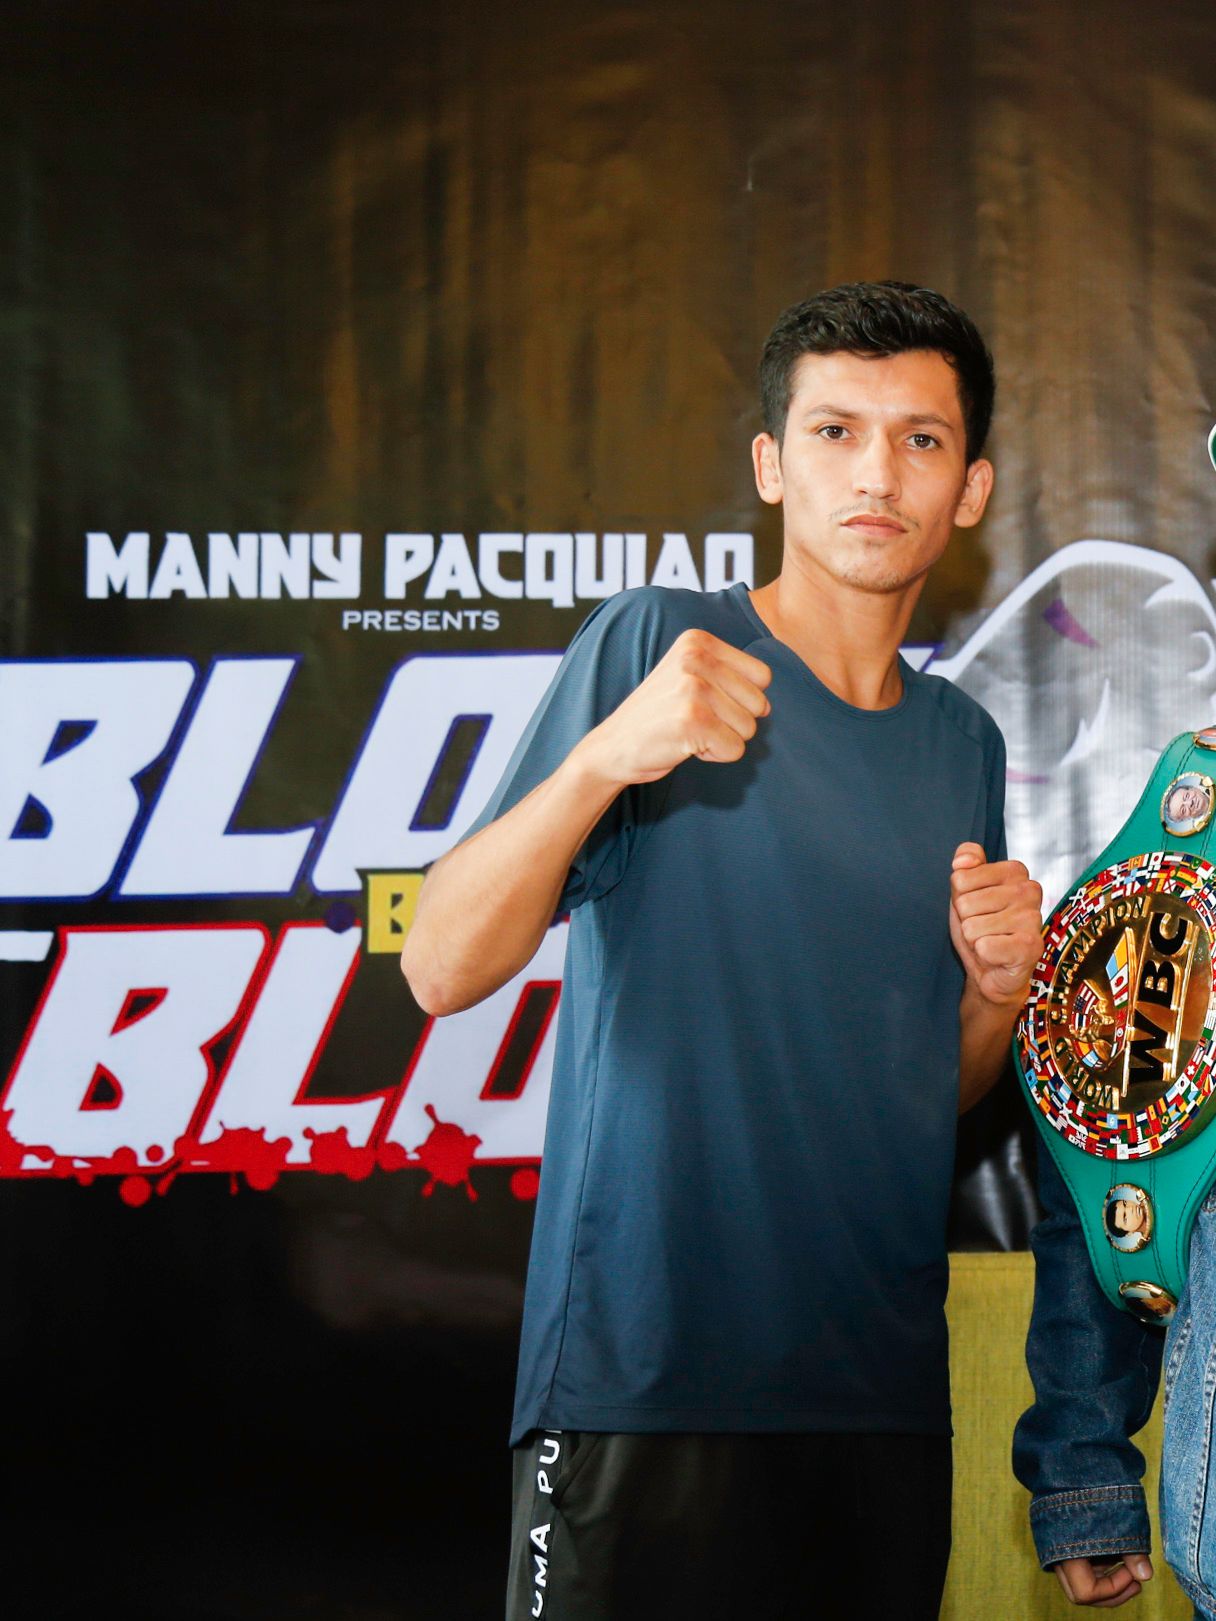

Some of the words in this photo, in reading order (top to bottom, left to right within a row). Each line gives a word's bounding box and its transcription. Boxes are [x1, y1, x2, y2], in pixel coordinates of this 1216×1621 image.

[86, 532, 362, 599] MANNY
[386, 532, 755, 608] PACQUIAO
[343, 610, 500, 631] PRESENTS
[0, 653, 568, 897] BLO
[1050, 894, 1151, 1024] CHAMPION
[1129, 912, 1192, 1083] WBC
[1055, 1036, 1120, 1110] WORLD
[530, 1523, 550, 1619] UMA
